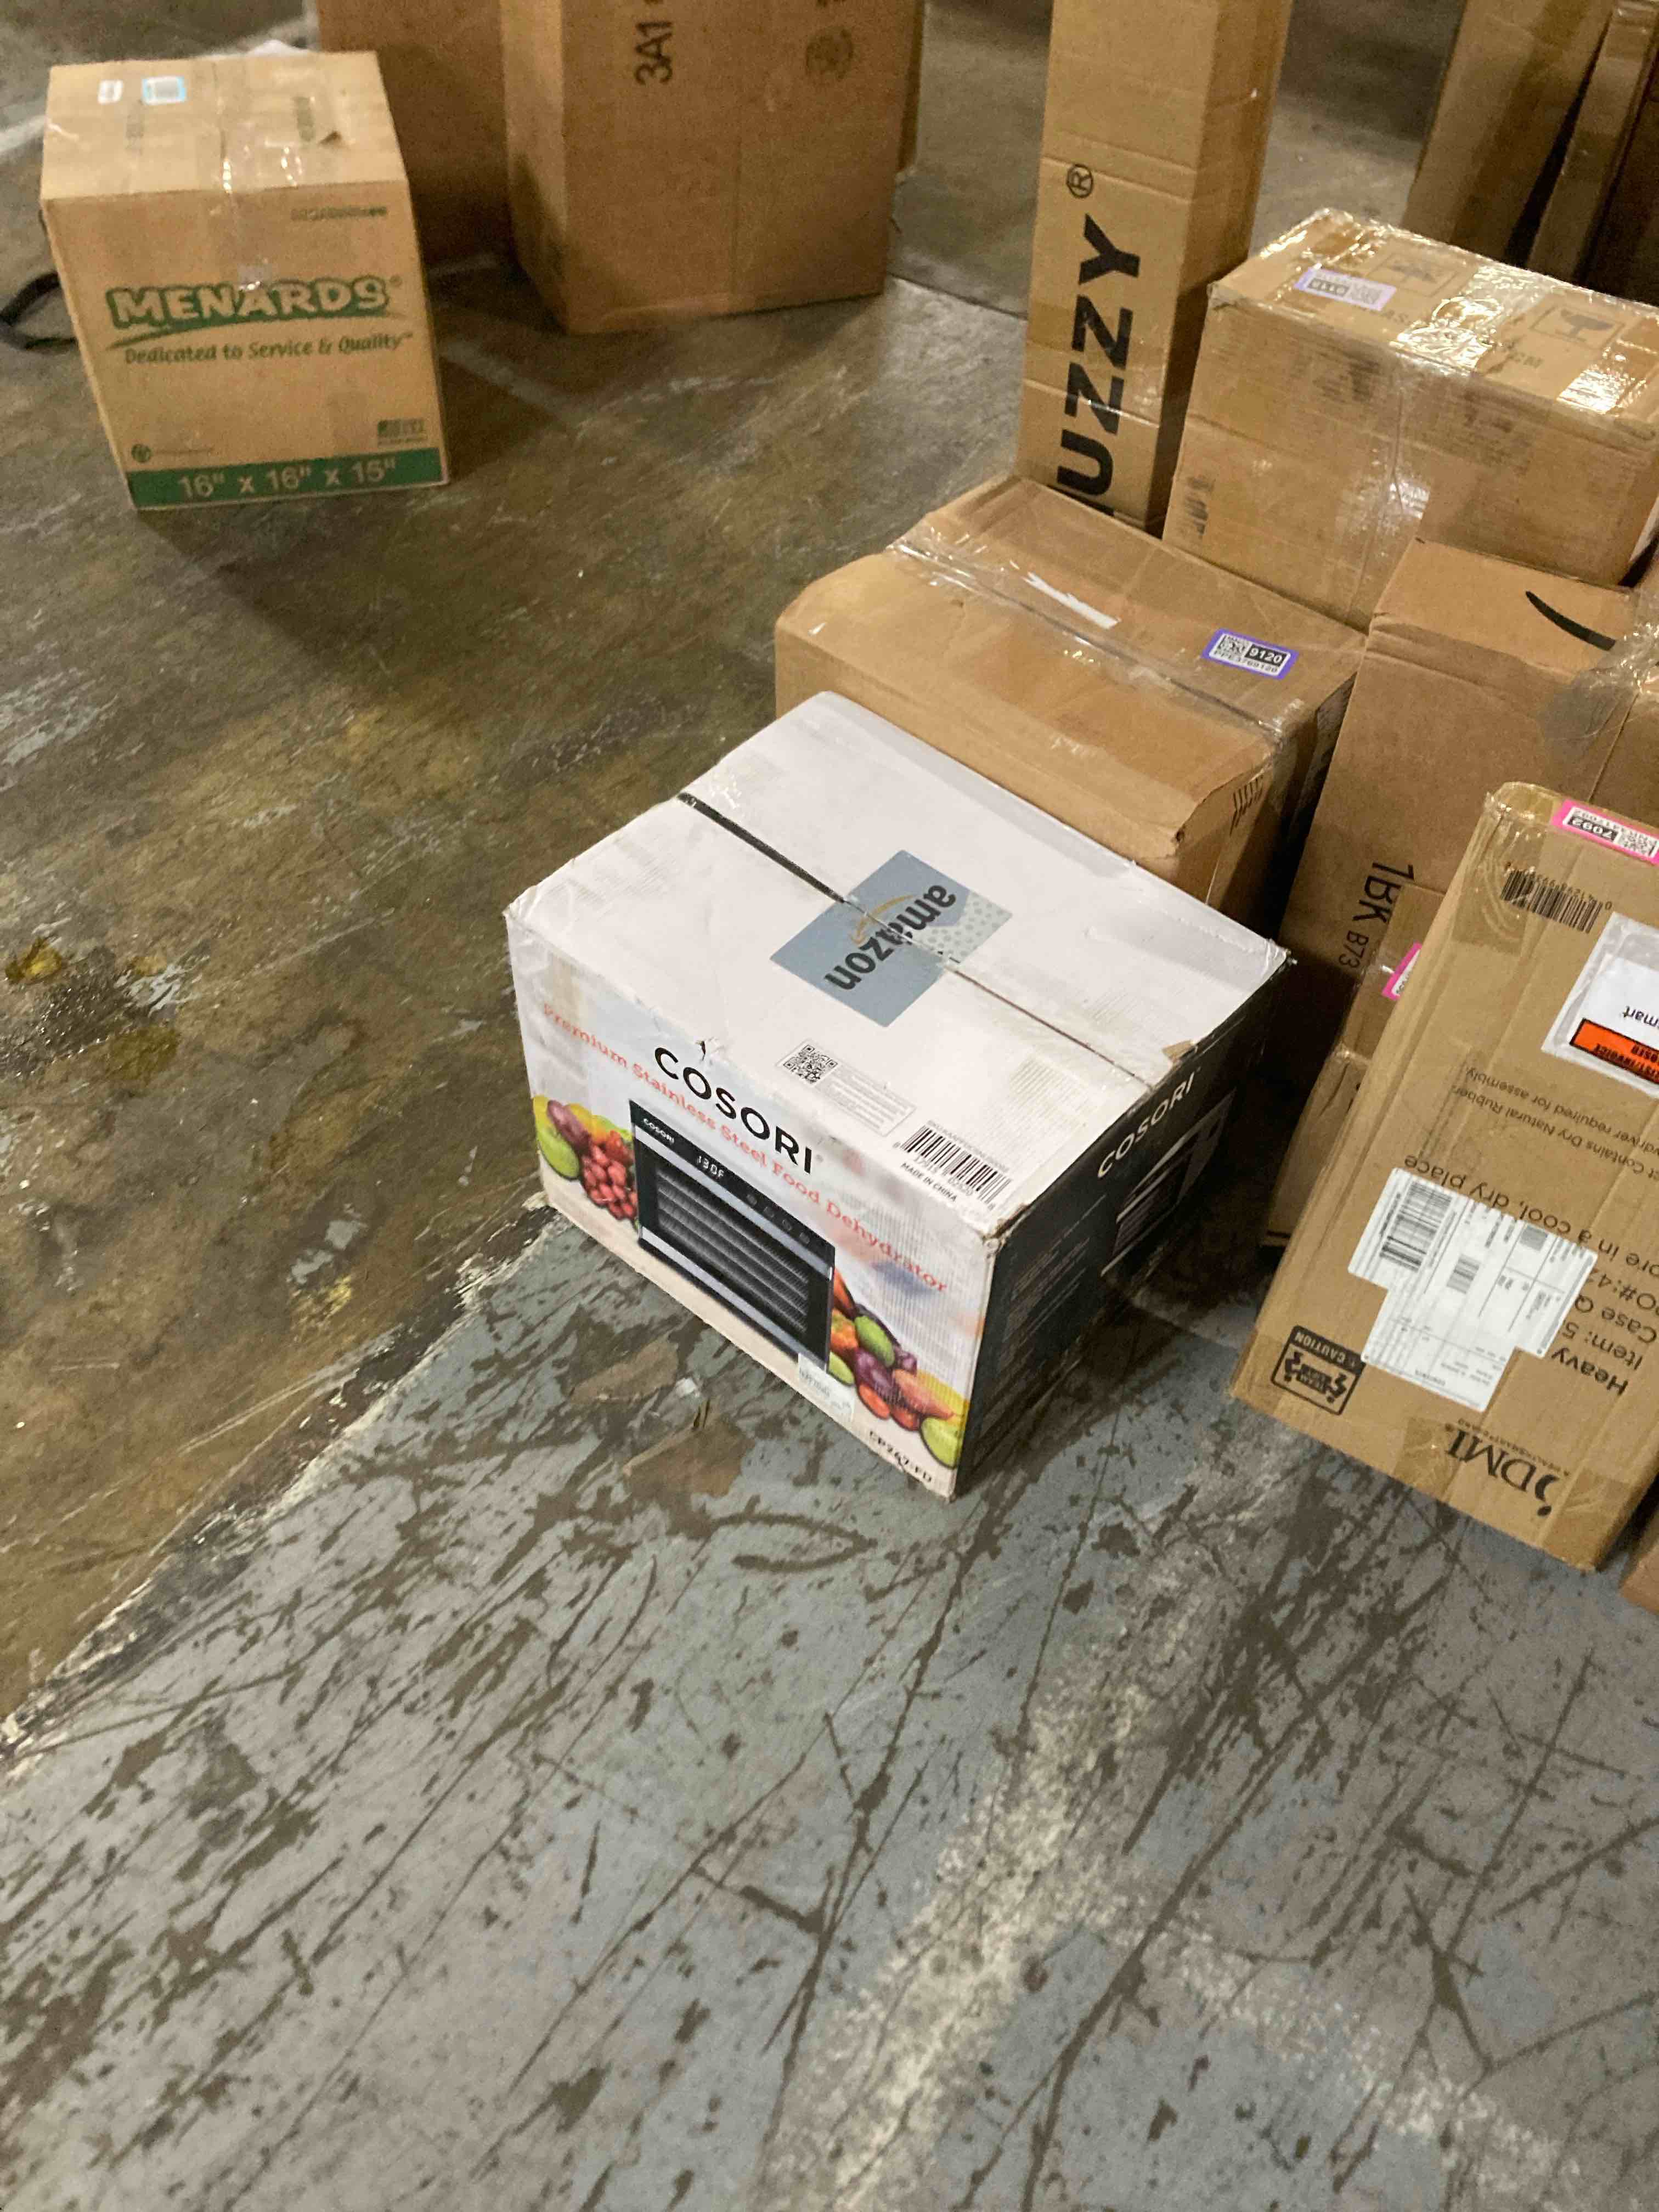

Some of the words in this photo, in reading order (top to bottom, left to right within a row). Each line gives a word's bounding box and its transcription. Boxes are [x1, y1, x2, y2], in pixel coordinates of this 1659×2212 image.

[634, 19, 675, 85] 3A1
[125, 341, 217, 364] Dedicated
[222, 343, 243, 360] to
[247, 336, 313, 359] Service
[318, 337, 331, 355] &
[1056, 164, 1141, 516] UZZY®
[177, 471, 225, 498] 16"
[266, 465, 313, 492] 16"
[351, 458, 397, 483] 15"
[1249, 647, 1283, 664] 9120
[825, 885, 956, 990] amazon
[1338, 930, 1370, 969] B73
[1623, 1006, 1659, 1028] mart
[654, 1047, 813, 1174] COSORI
[1533, 1095, 1551, 1110] for
[1553, 1104, 1612, 1135] required
[1098, 1072, 1195, 1180] COSORI
[1505, 1107, 1556, 1137] Natural
[1558, 1128, 1583, 1149] Dry
[543, 1002, 629, 1071] Premium
[632, 1063, 716, 1130] Stainless
[721, 1125, 767, 1168] Steel
[772, 1160, 821, 1204] Food
[826, 1201, 948, 1293] Dehydrator
[1587, 1140, 1645, 1174] Contains
[901, 1161, 923, 1180] MADE
[923, 1176, 933, 1186] IN
[933, 1182, 957, 1201] CHINA
[1404, 1154, 1467, 1190] place
[1469, 1181, 1510, 1209] dry
[1518, 1200, 1571, 1234] cool,
[1578, 1229, 1592, 1244] a
[1598, 1238, 1620, 1262] in
[1601, 1307, 1657, 1344] Case
[1295, 1330, 1347, 1369] CAUTION
[1584, 1331, 1643, 1370] Item:
[1551, 1347, 1629, 1396] Heavy
